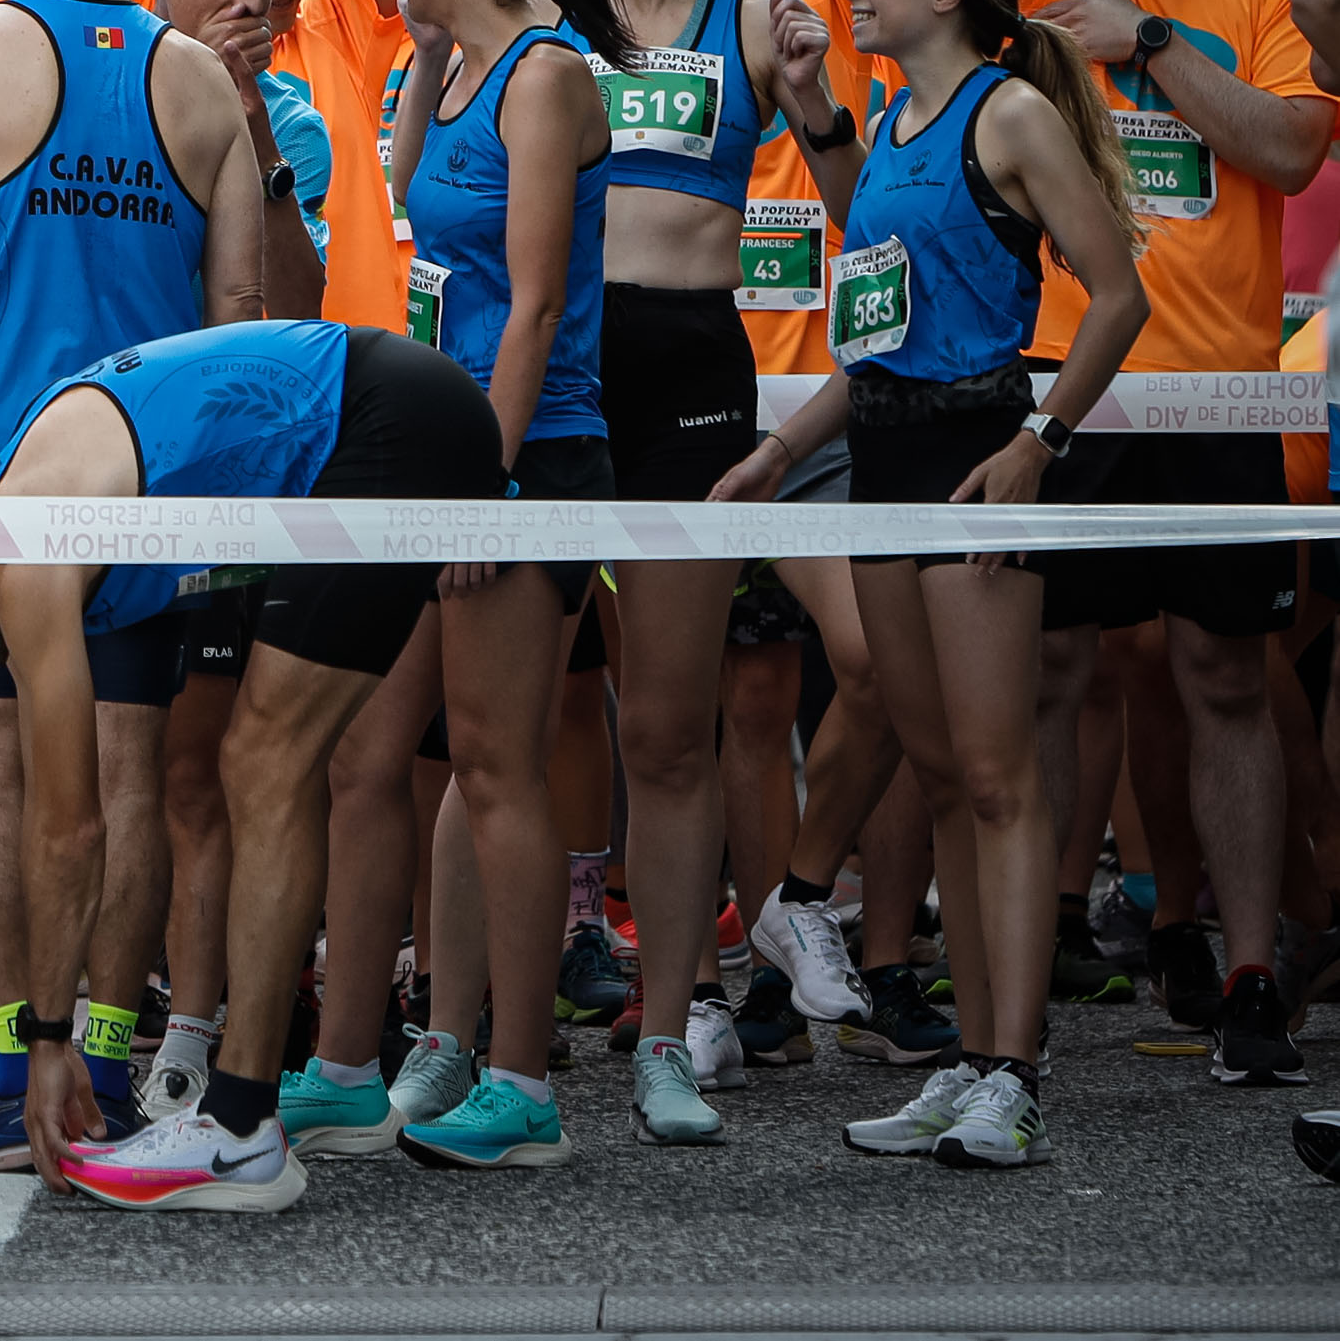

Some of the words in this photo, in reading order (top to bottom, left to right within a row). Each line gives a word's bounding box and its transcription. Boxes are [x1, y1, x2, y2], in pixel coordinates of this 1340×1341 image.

[654, 52, 716, 68] POPULAR
[621, 90, 697, 125] 519
[706, 96, 716, 115] 5K
[1153, 151, 1183, 159] ALBERTO
[49, 153, 163, 190] C.A.V.A.
[1138, 169, 1178, 189] 306
[28, 188, 175, 229] ANDORRA
[761, 207, 821, 216] POPULAR
[740, 239, 795, 248] FRANCESC
[754, 260, 781, 280] 43
[854, 287, 895, 331] 583
[679, 410, 727, 427] luanvi
